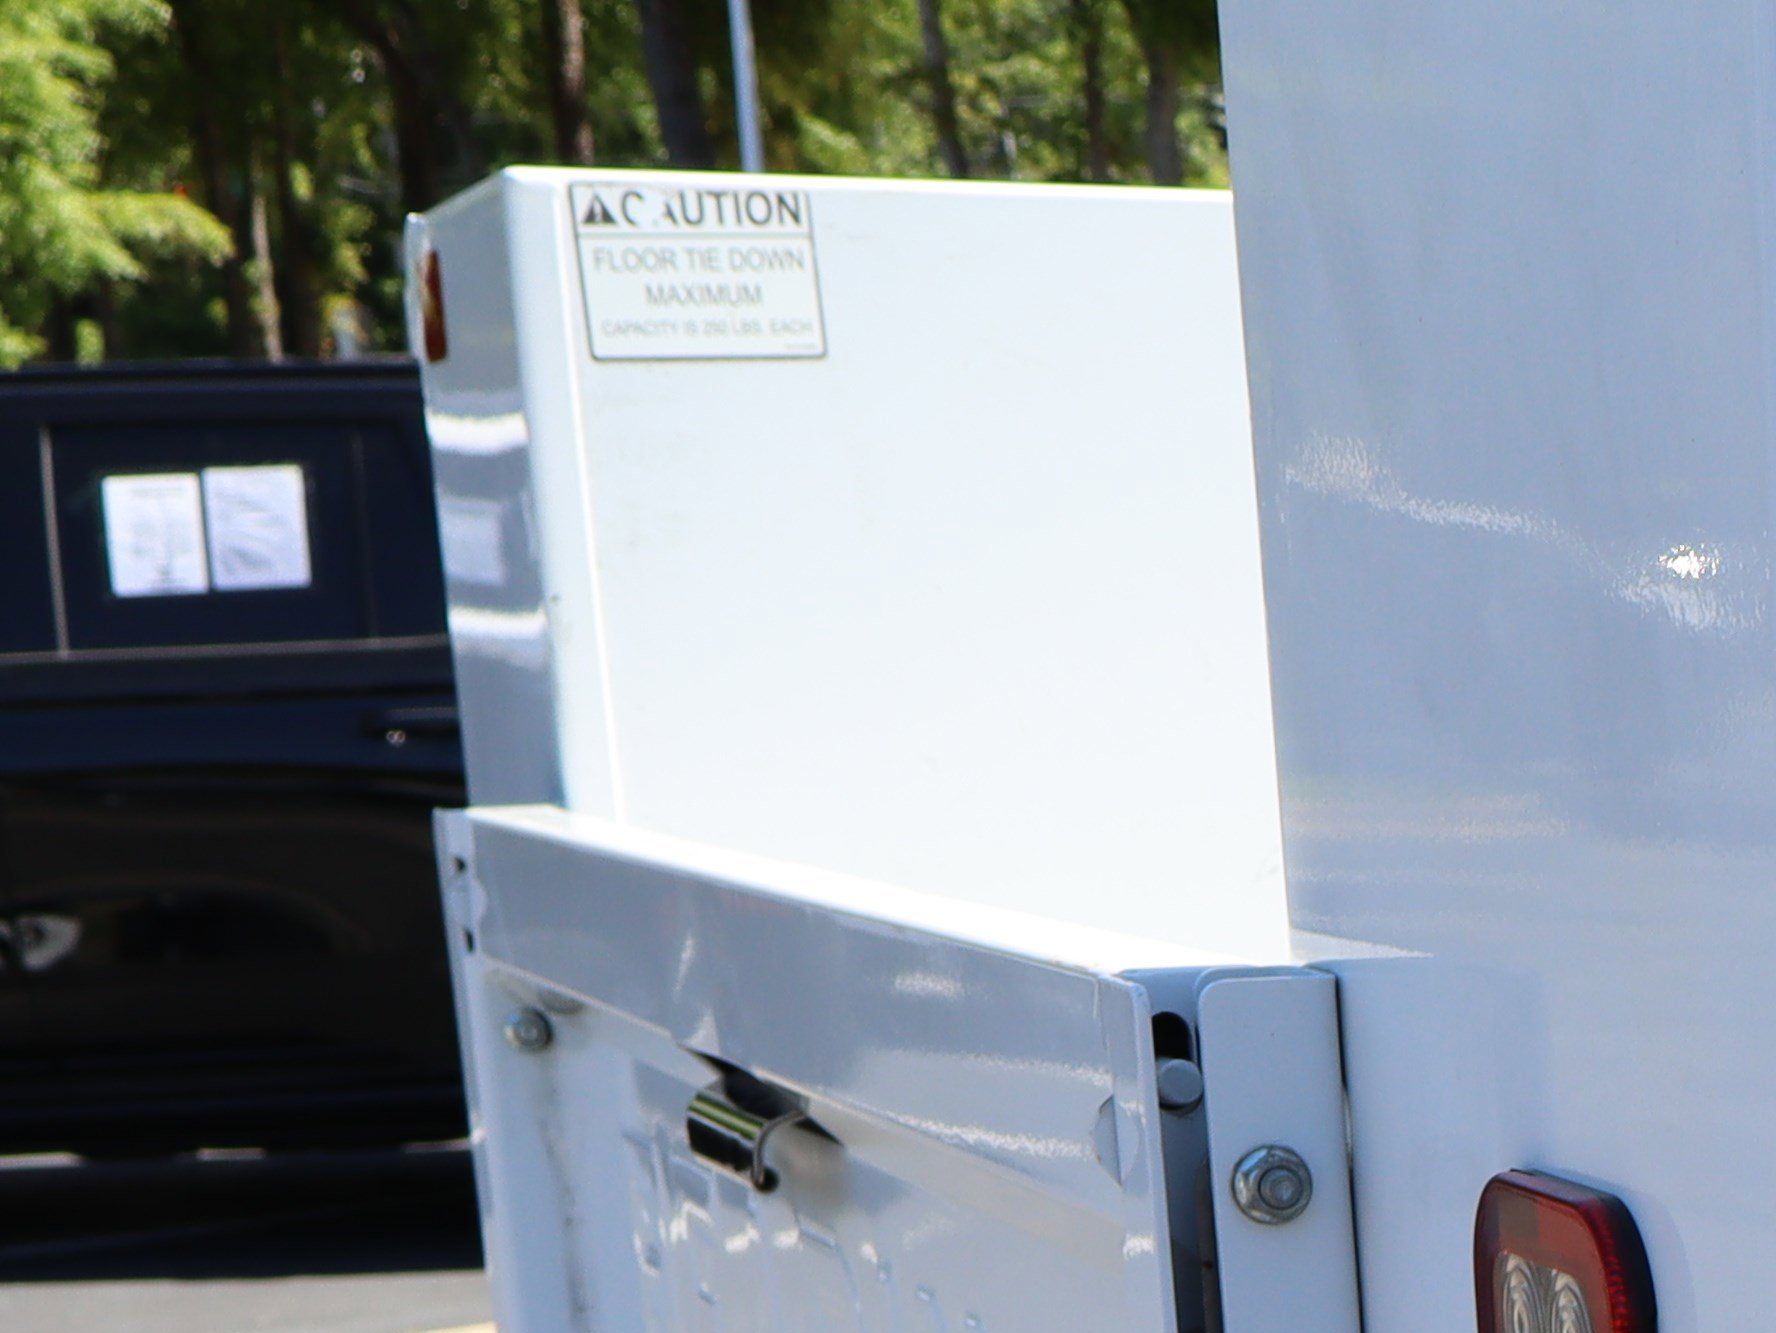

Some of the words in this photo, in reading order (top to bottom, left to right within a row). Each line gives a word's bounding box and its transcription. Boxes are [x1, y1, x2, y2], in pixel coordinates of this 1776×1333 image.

[593, 247, 679, 272] FLOOR
[686, 247, 720, 271] TIE
[728, 247, 805, 271] DOWN
[646, 284, 763, 307] MAXIMUM
[600, 318, 678, 338] CAPACITY
